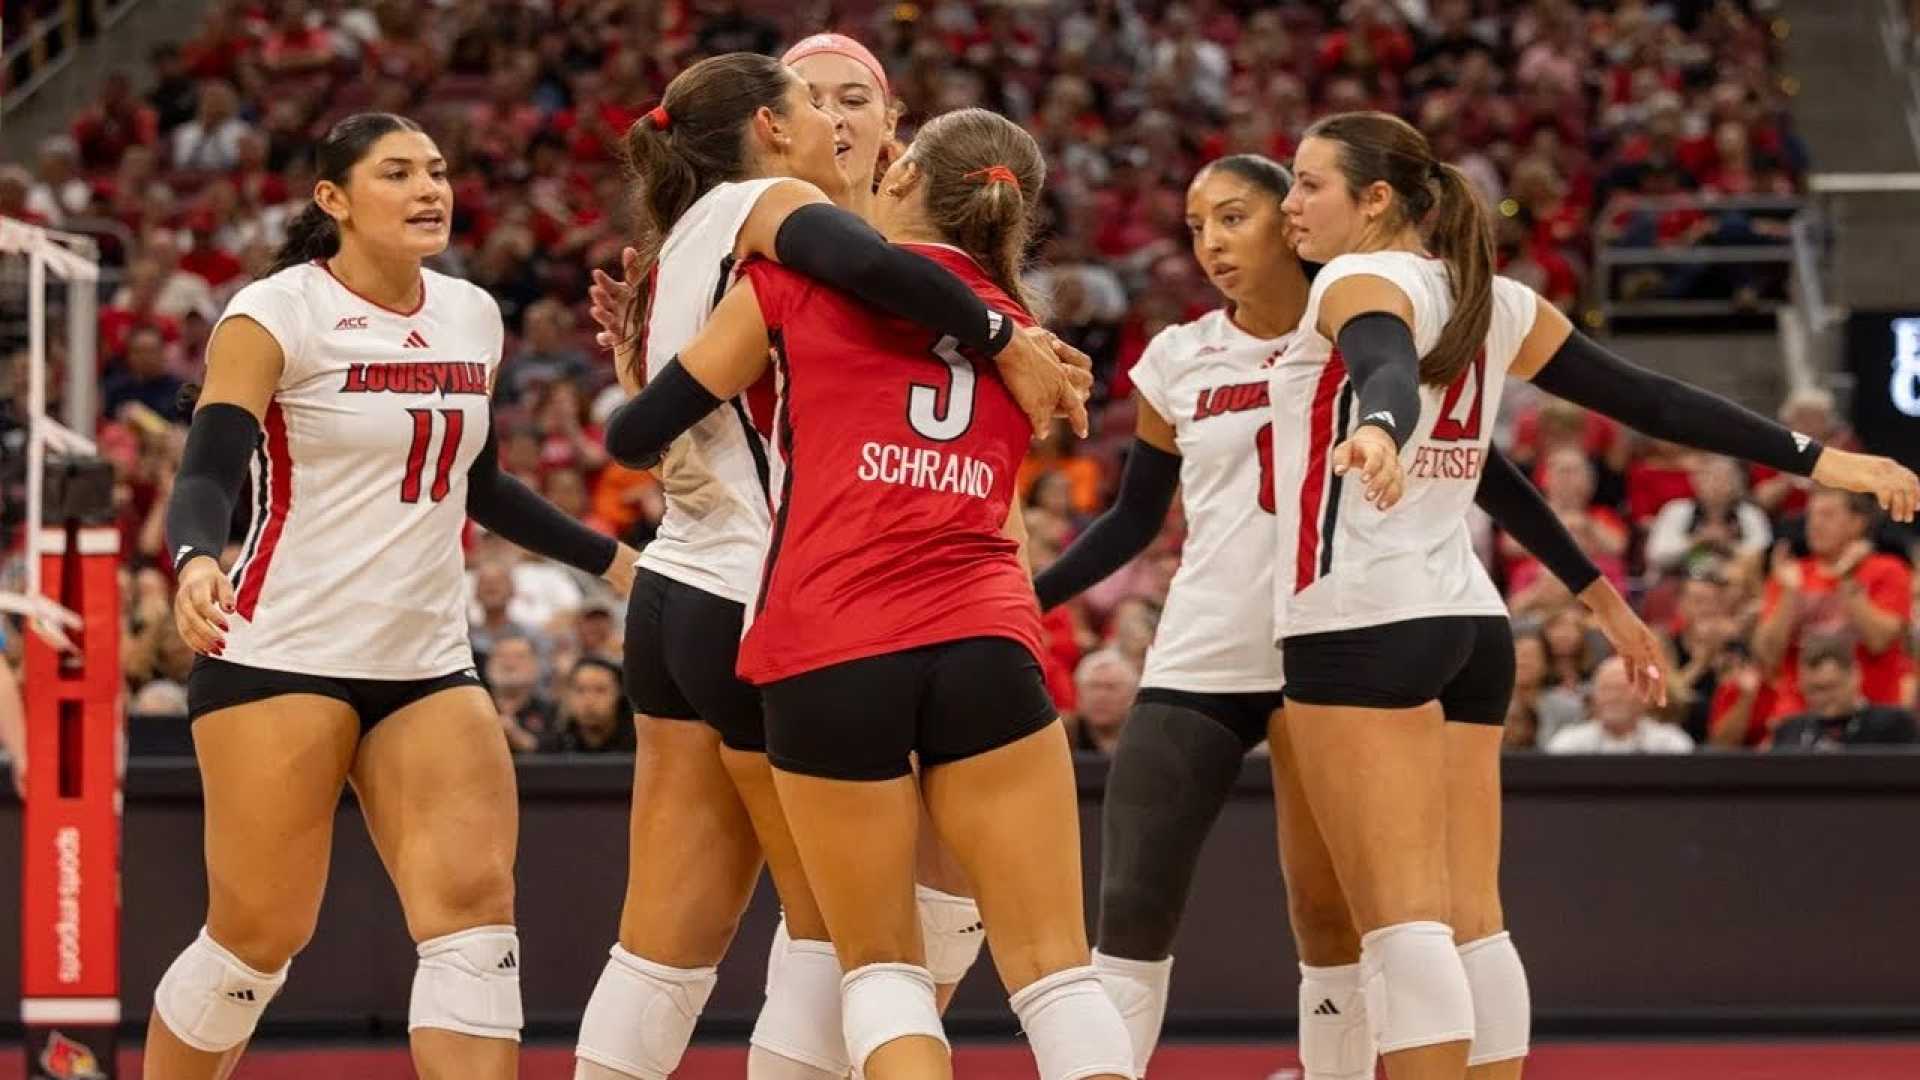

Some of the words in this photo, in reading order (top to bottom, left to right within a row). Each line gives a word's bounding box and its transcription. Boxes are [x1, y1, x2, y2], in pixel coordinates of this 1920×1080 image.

[334, 316, 368, 330] ACC
[401, 409, 463, 503] 11
[857, 441, 994, 499] SCHRAND
